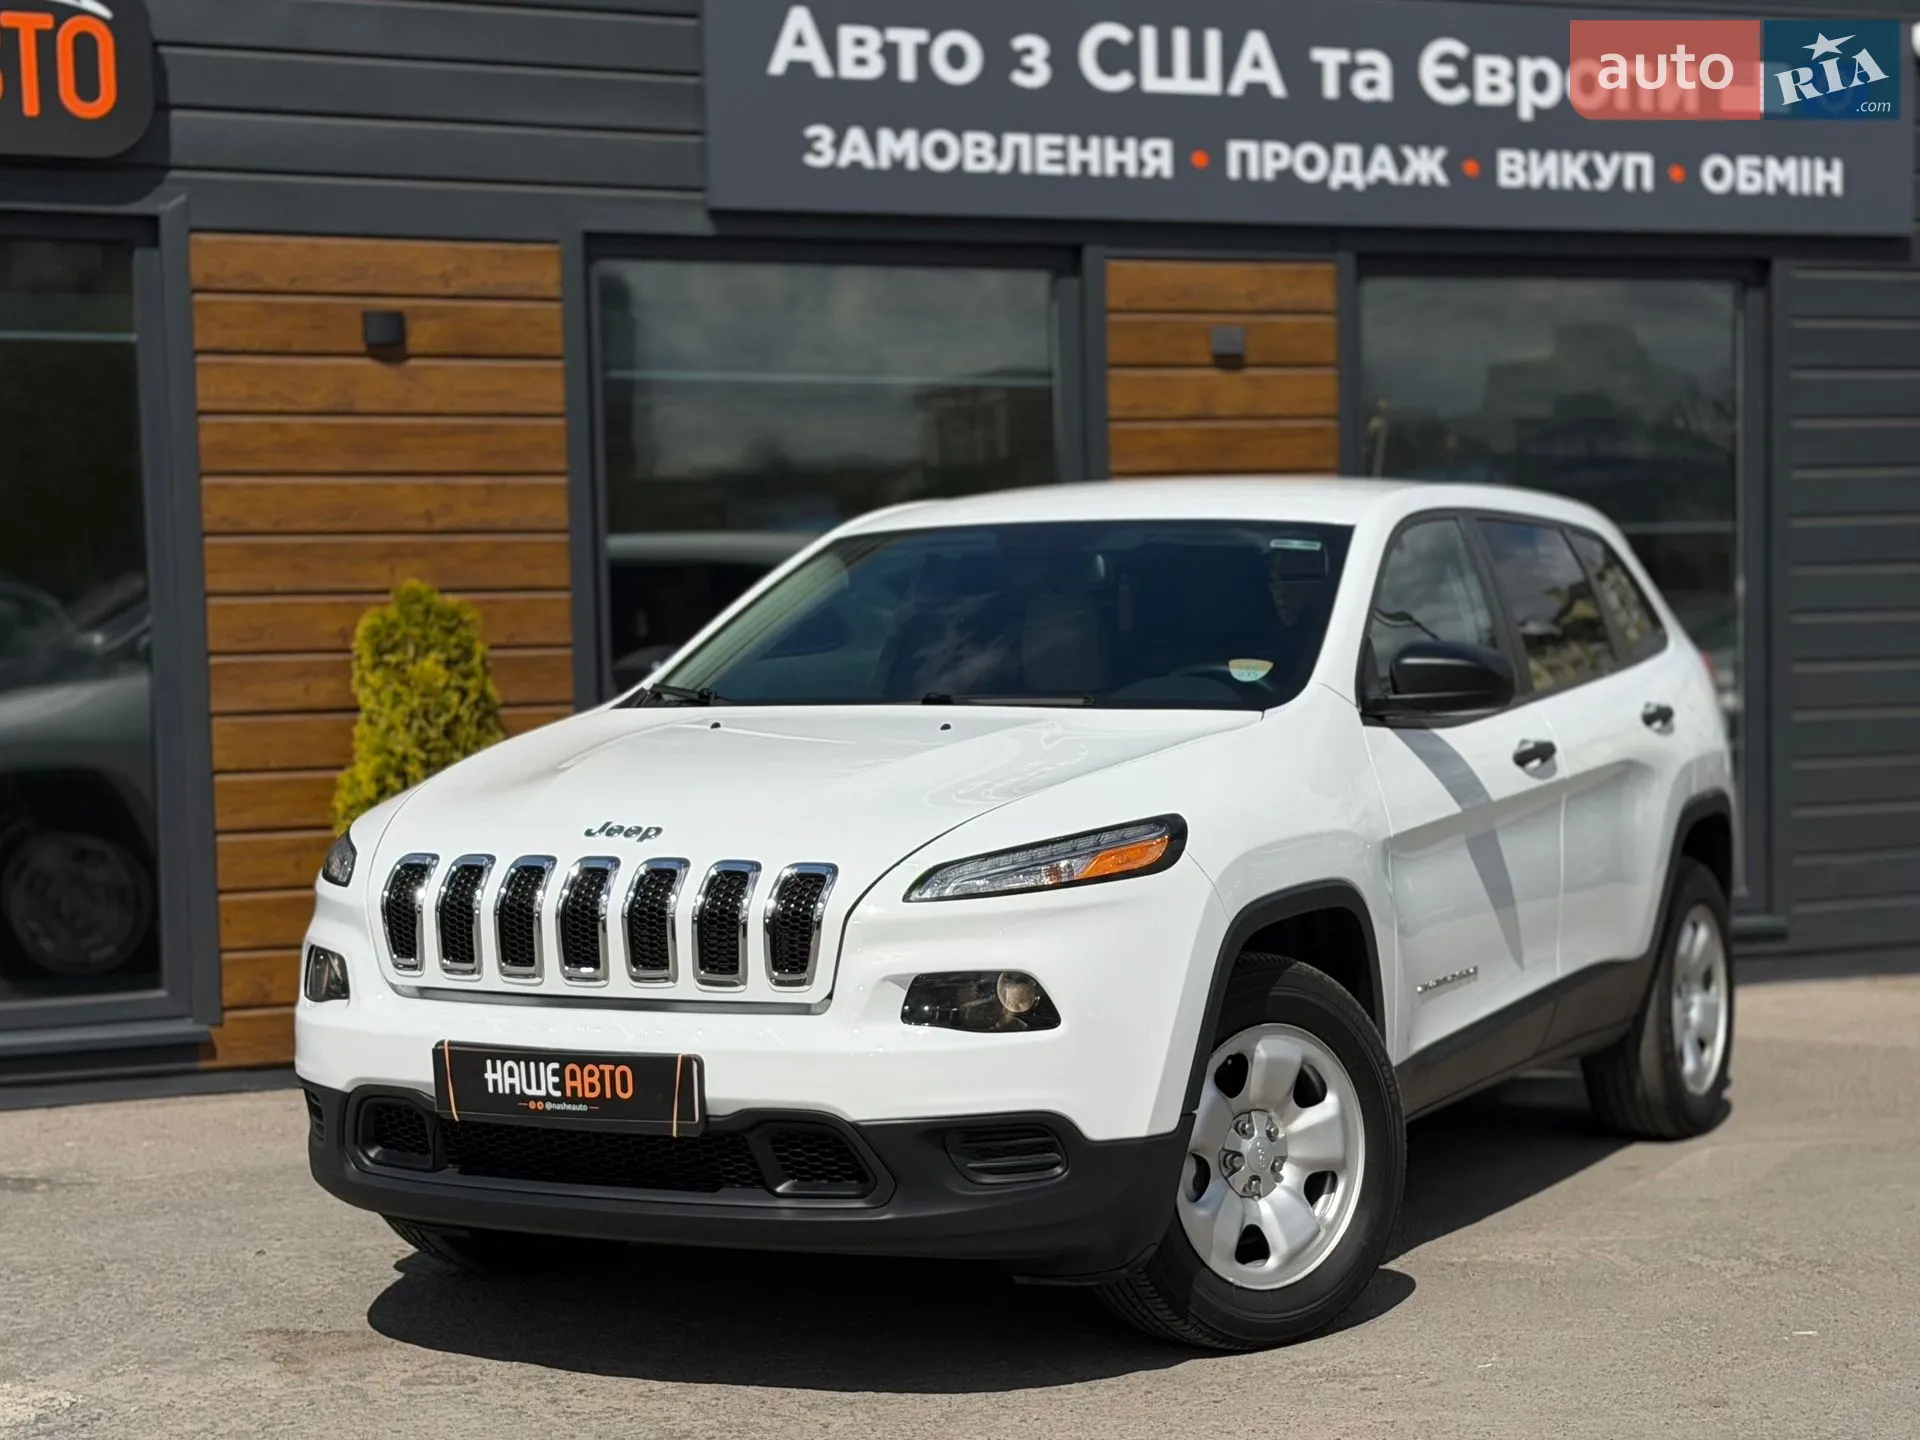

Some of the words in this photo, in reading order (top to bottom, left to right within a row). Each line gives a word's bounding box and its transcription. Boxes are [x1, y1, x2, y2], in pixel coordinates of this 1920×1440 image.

[0, 10, 118, 121] ТО
[767, 4, 984, 86] Авто
[1009, 33, 1052, 89] з
[1077, 21, 1288, 99] США
[1310, 46, 1394, 102] та
[803, 123, 1174, 179] ЗАМОВЛЕННЯ
[1226, 139, 1449, 191] ПРОДАЖ
[1496, 148, 1655, 192] ВИКУП
[1699, 153, 1844, 196] ОБМІН
[584, 821, 663, 843] Jeep
[484, 1058, 562, 1097] НАШЕ
[564, 1063, 634, 1100] АВТО
[545, 1101, 588, 1112] @nasheauto
